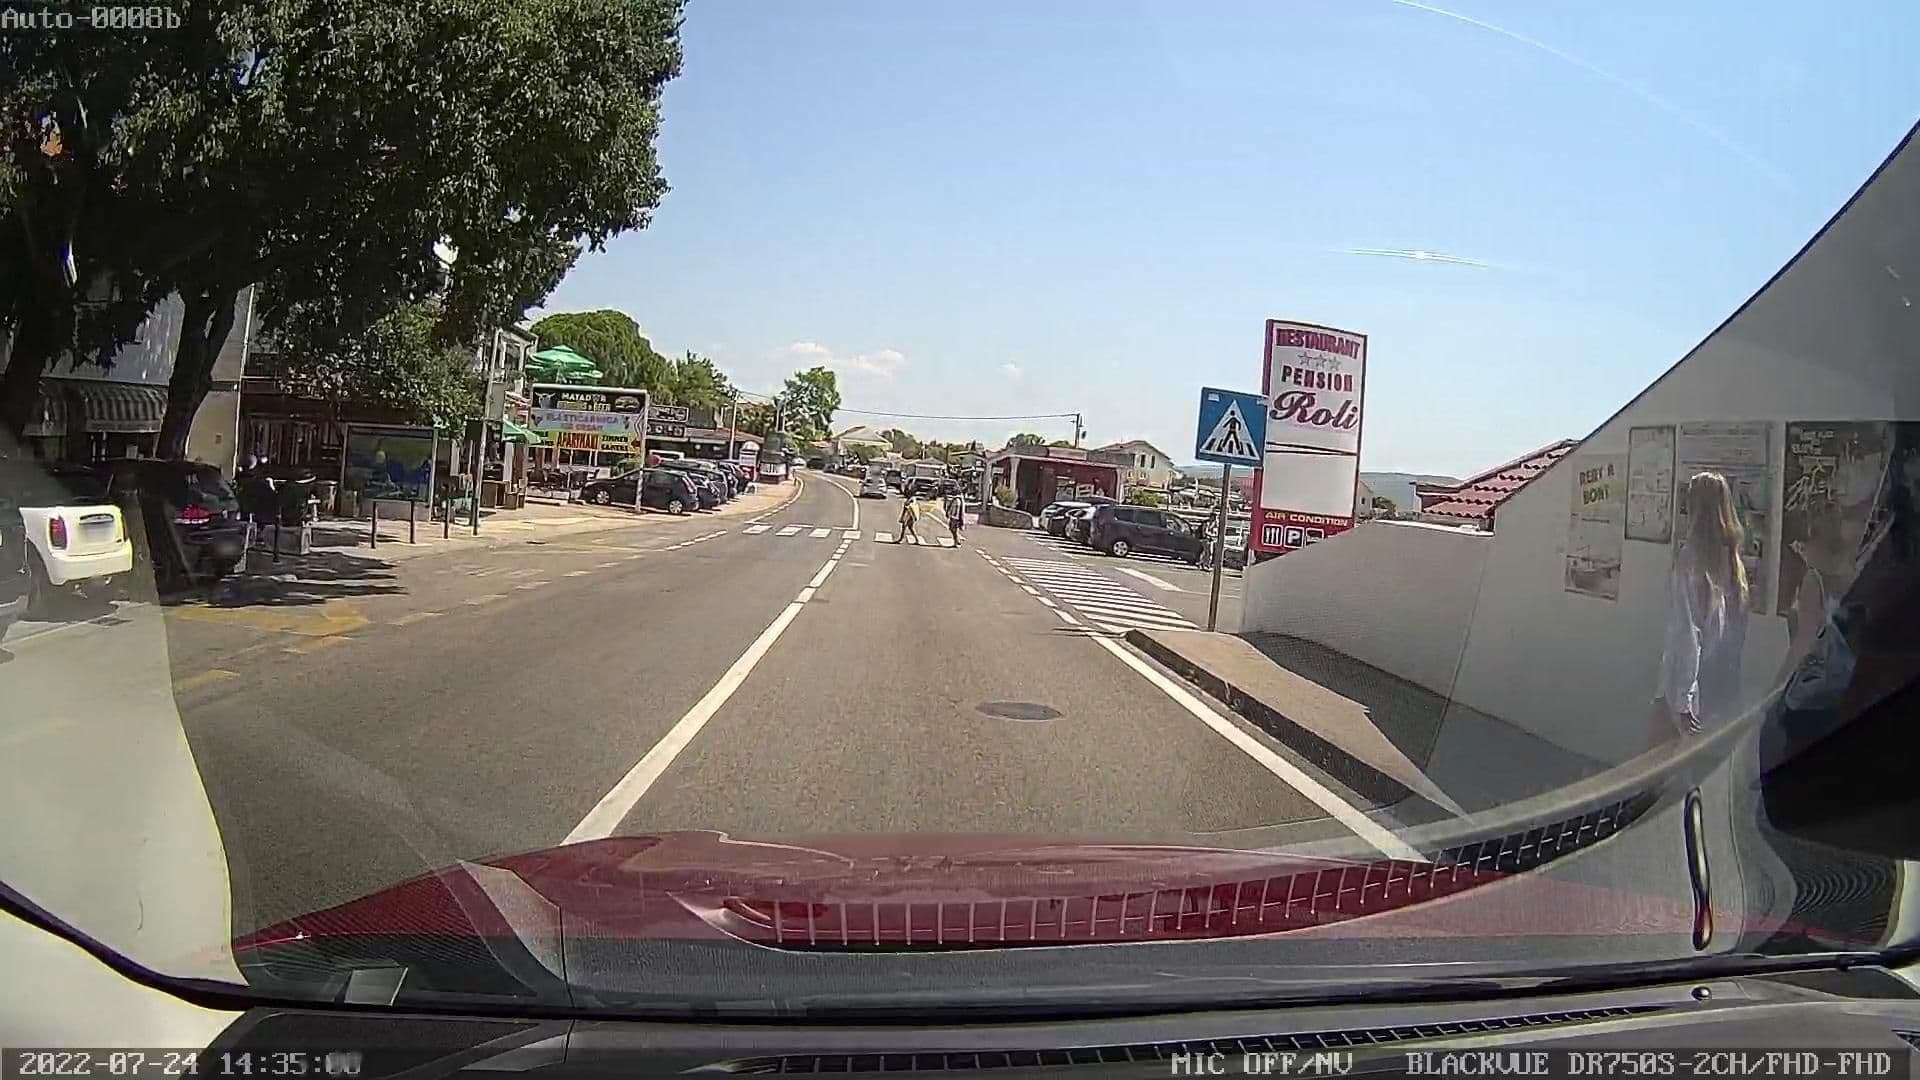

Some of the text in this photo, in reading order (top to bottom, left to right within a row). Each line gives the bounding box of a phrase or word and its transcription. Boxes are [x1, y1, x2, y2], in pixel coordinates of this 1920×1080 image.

[1276, 328, 1361, 360] RESTAURANT
[1281, 364, 1353, 393] PENSION
[1269, 389, 1359, 430] Roli
[1264, 511, 1349, 527] AIR CONDITION
